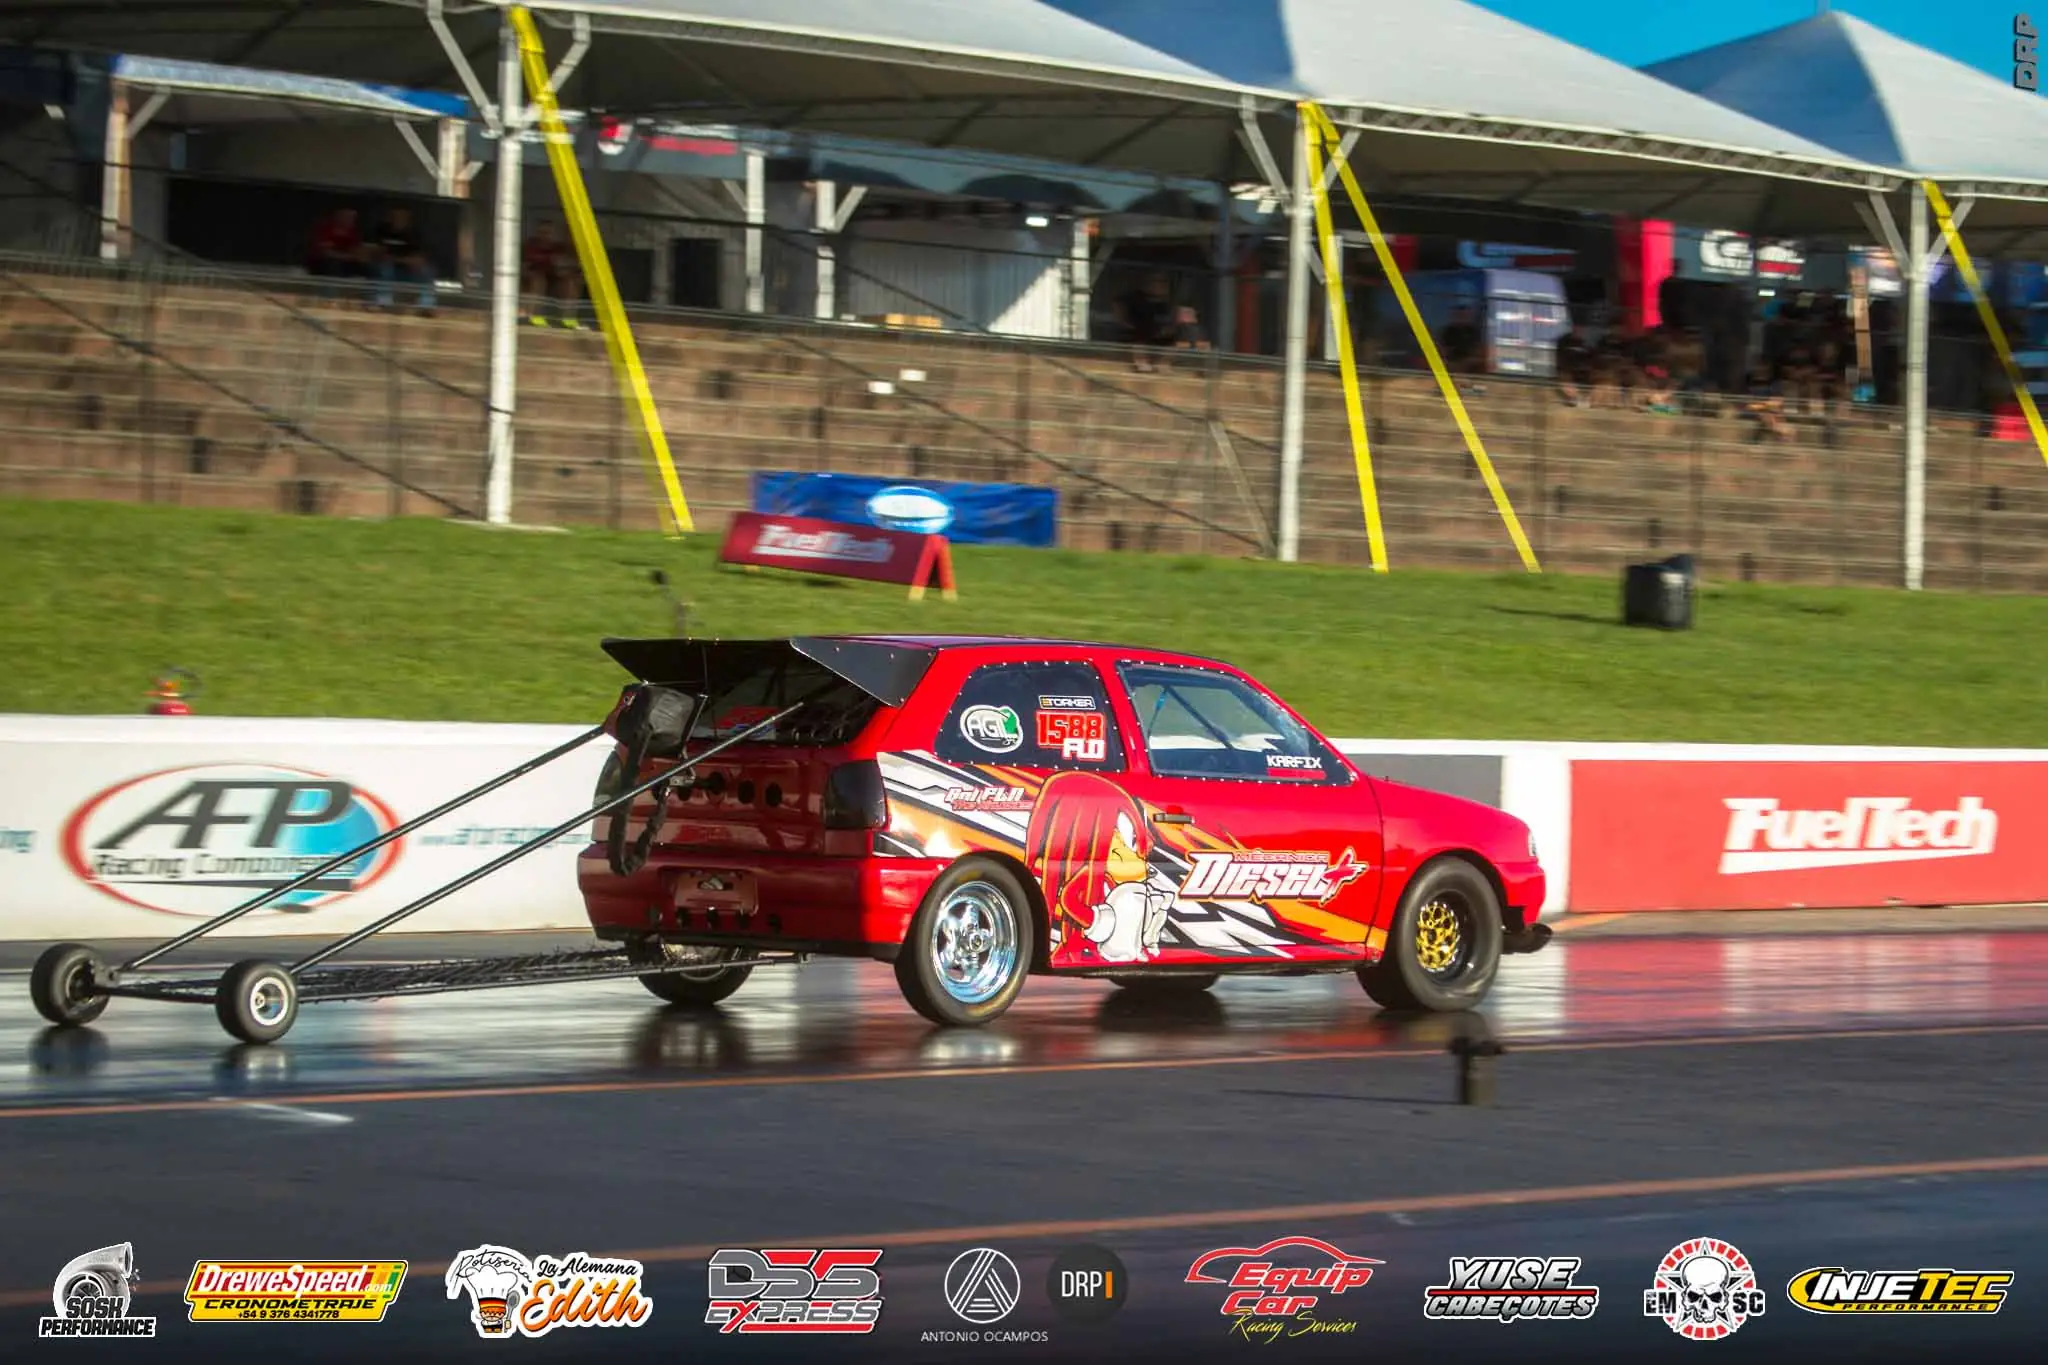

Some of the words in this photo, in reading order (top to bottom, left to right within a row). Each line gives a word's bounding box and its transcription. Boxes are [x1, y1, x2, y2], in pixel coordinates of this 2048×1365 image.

[1037, 711, 1105, 748] 1588
[1265, 754, 1322, 769] KARFIX
[1720, 796, 1998, 854] FuelTech
[1180, 852, 1331, 897] DIESEL
